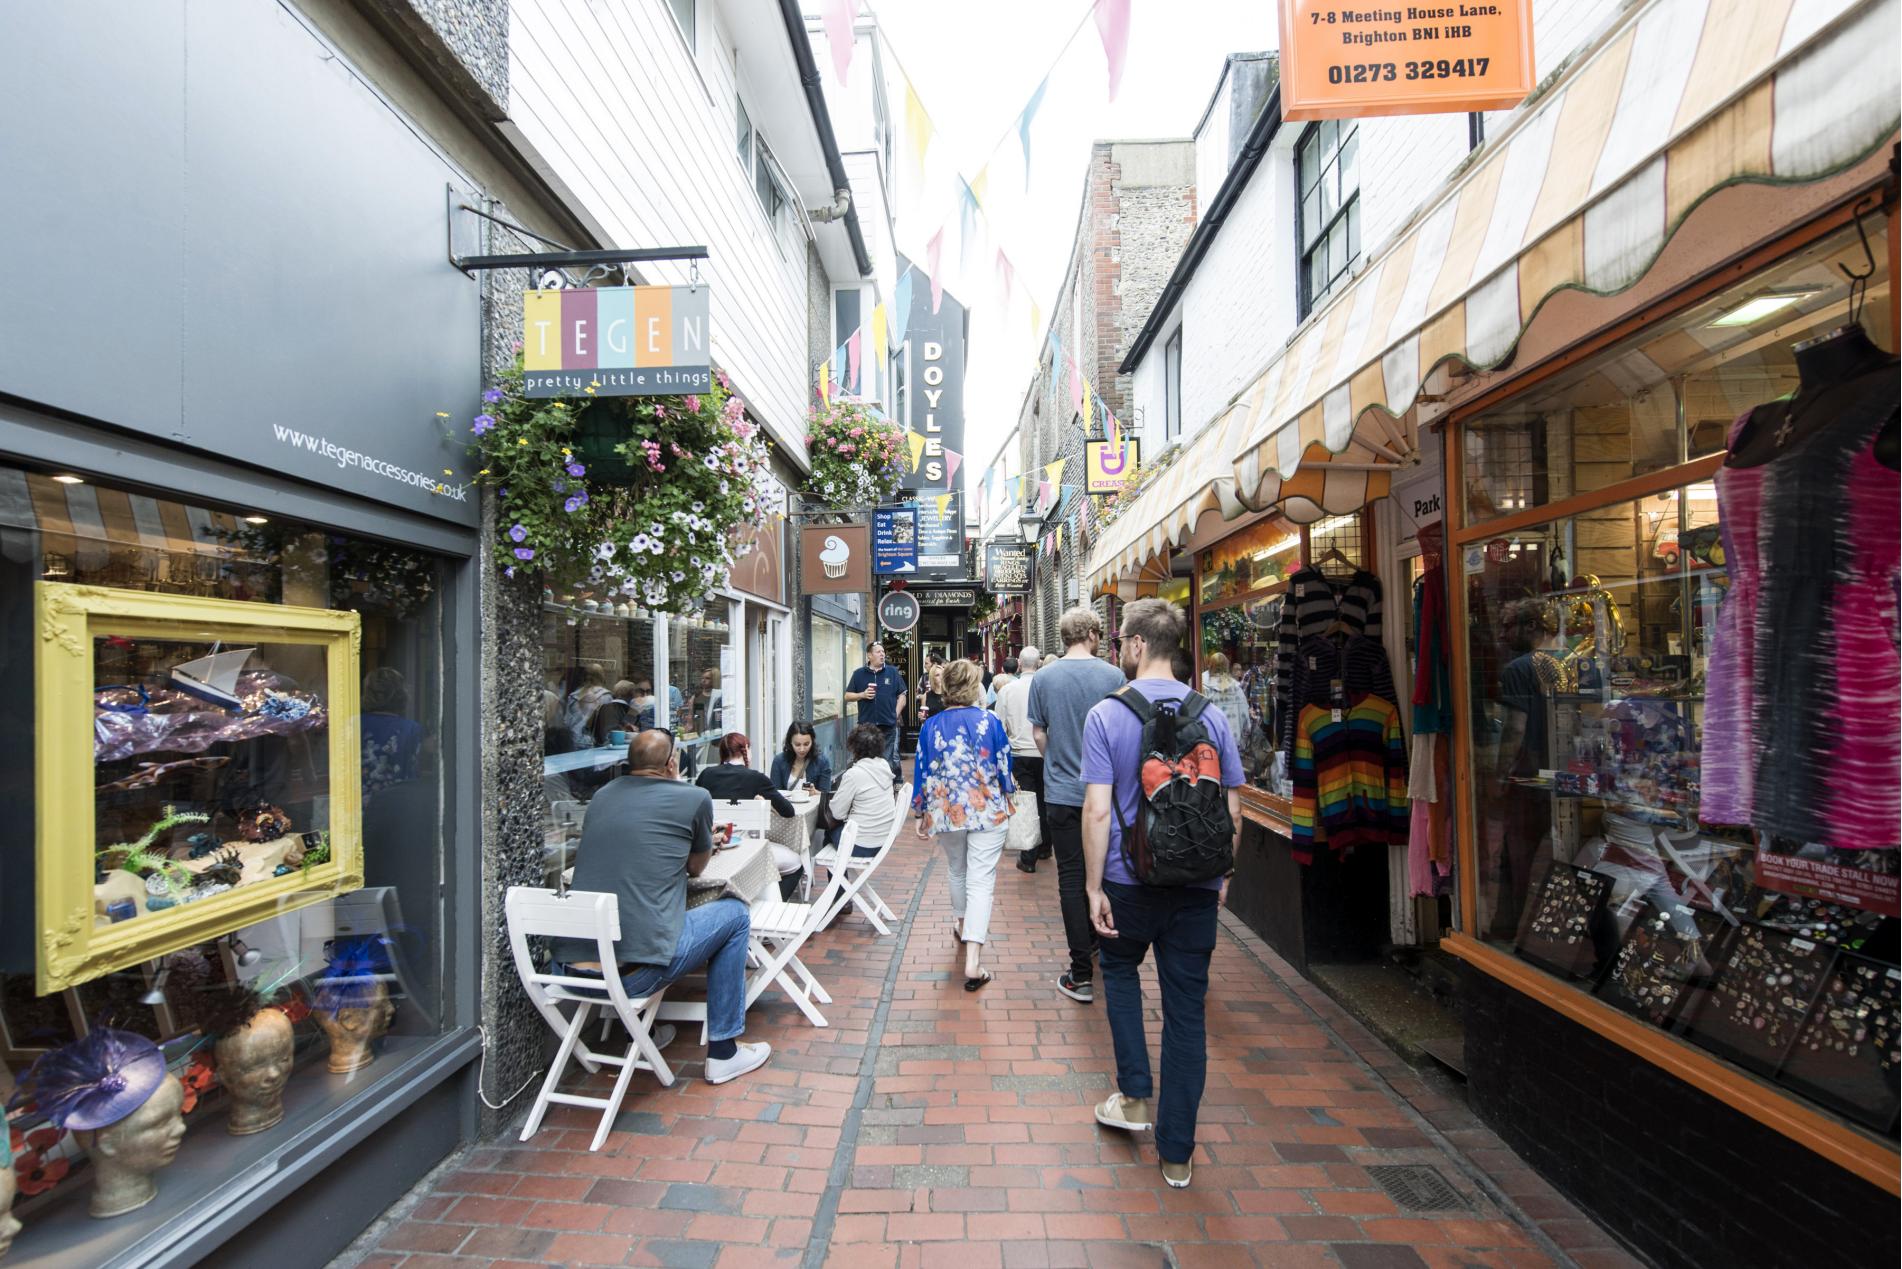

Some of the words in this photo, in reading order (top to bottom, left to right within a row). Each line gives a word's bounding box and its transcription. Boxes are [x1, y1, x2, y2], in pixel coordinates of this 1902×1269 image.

[1311, 12, 1336, 24] 7-8
[1341, 9, 1402, 24] Meeting
[1407, 6, 1454, 20] House
[1459, 4, 1502, 17] Lane,
[1342, 30, 1407, 46] Brighton
[1328, 63, 1397, 84] 01273
[1405, 57, 1490, 81] 329417
[534, 316, 700, 356] TEGEN
[527, 373, 581, 391] pretty
[593, 371, 645, 385] little
[656, 370, 709, 386] things
[923, 341, 944, 481] DOYLES
[1414, 494, 1441, 518] Park
[995, 548, 1026, 557] Wanted
[934, 591, 972, 599] DIAMONDS
[884, 603, 913, 619] ring
[1760, 852, 1784, 866] BOOK
[1785, 856, 1809, 870] YOUR
[1811, 861, 1839, 877] TRADE
[1841, 867, 1871, 883] STALL
[1872, 874, 1899, 888] NOW
